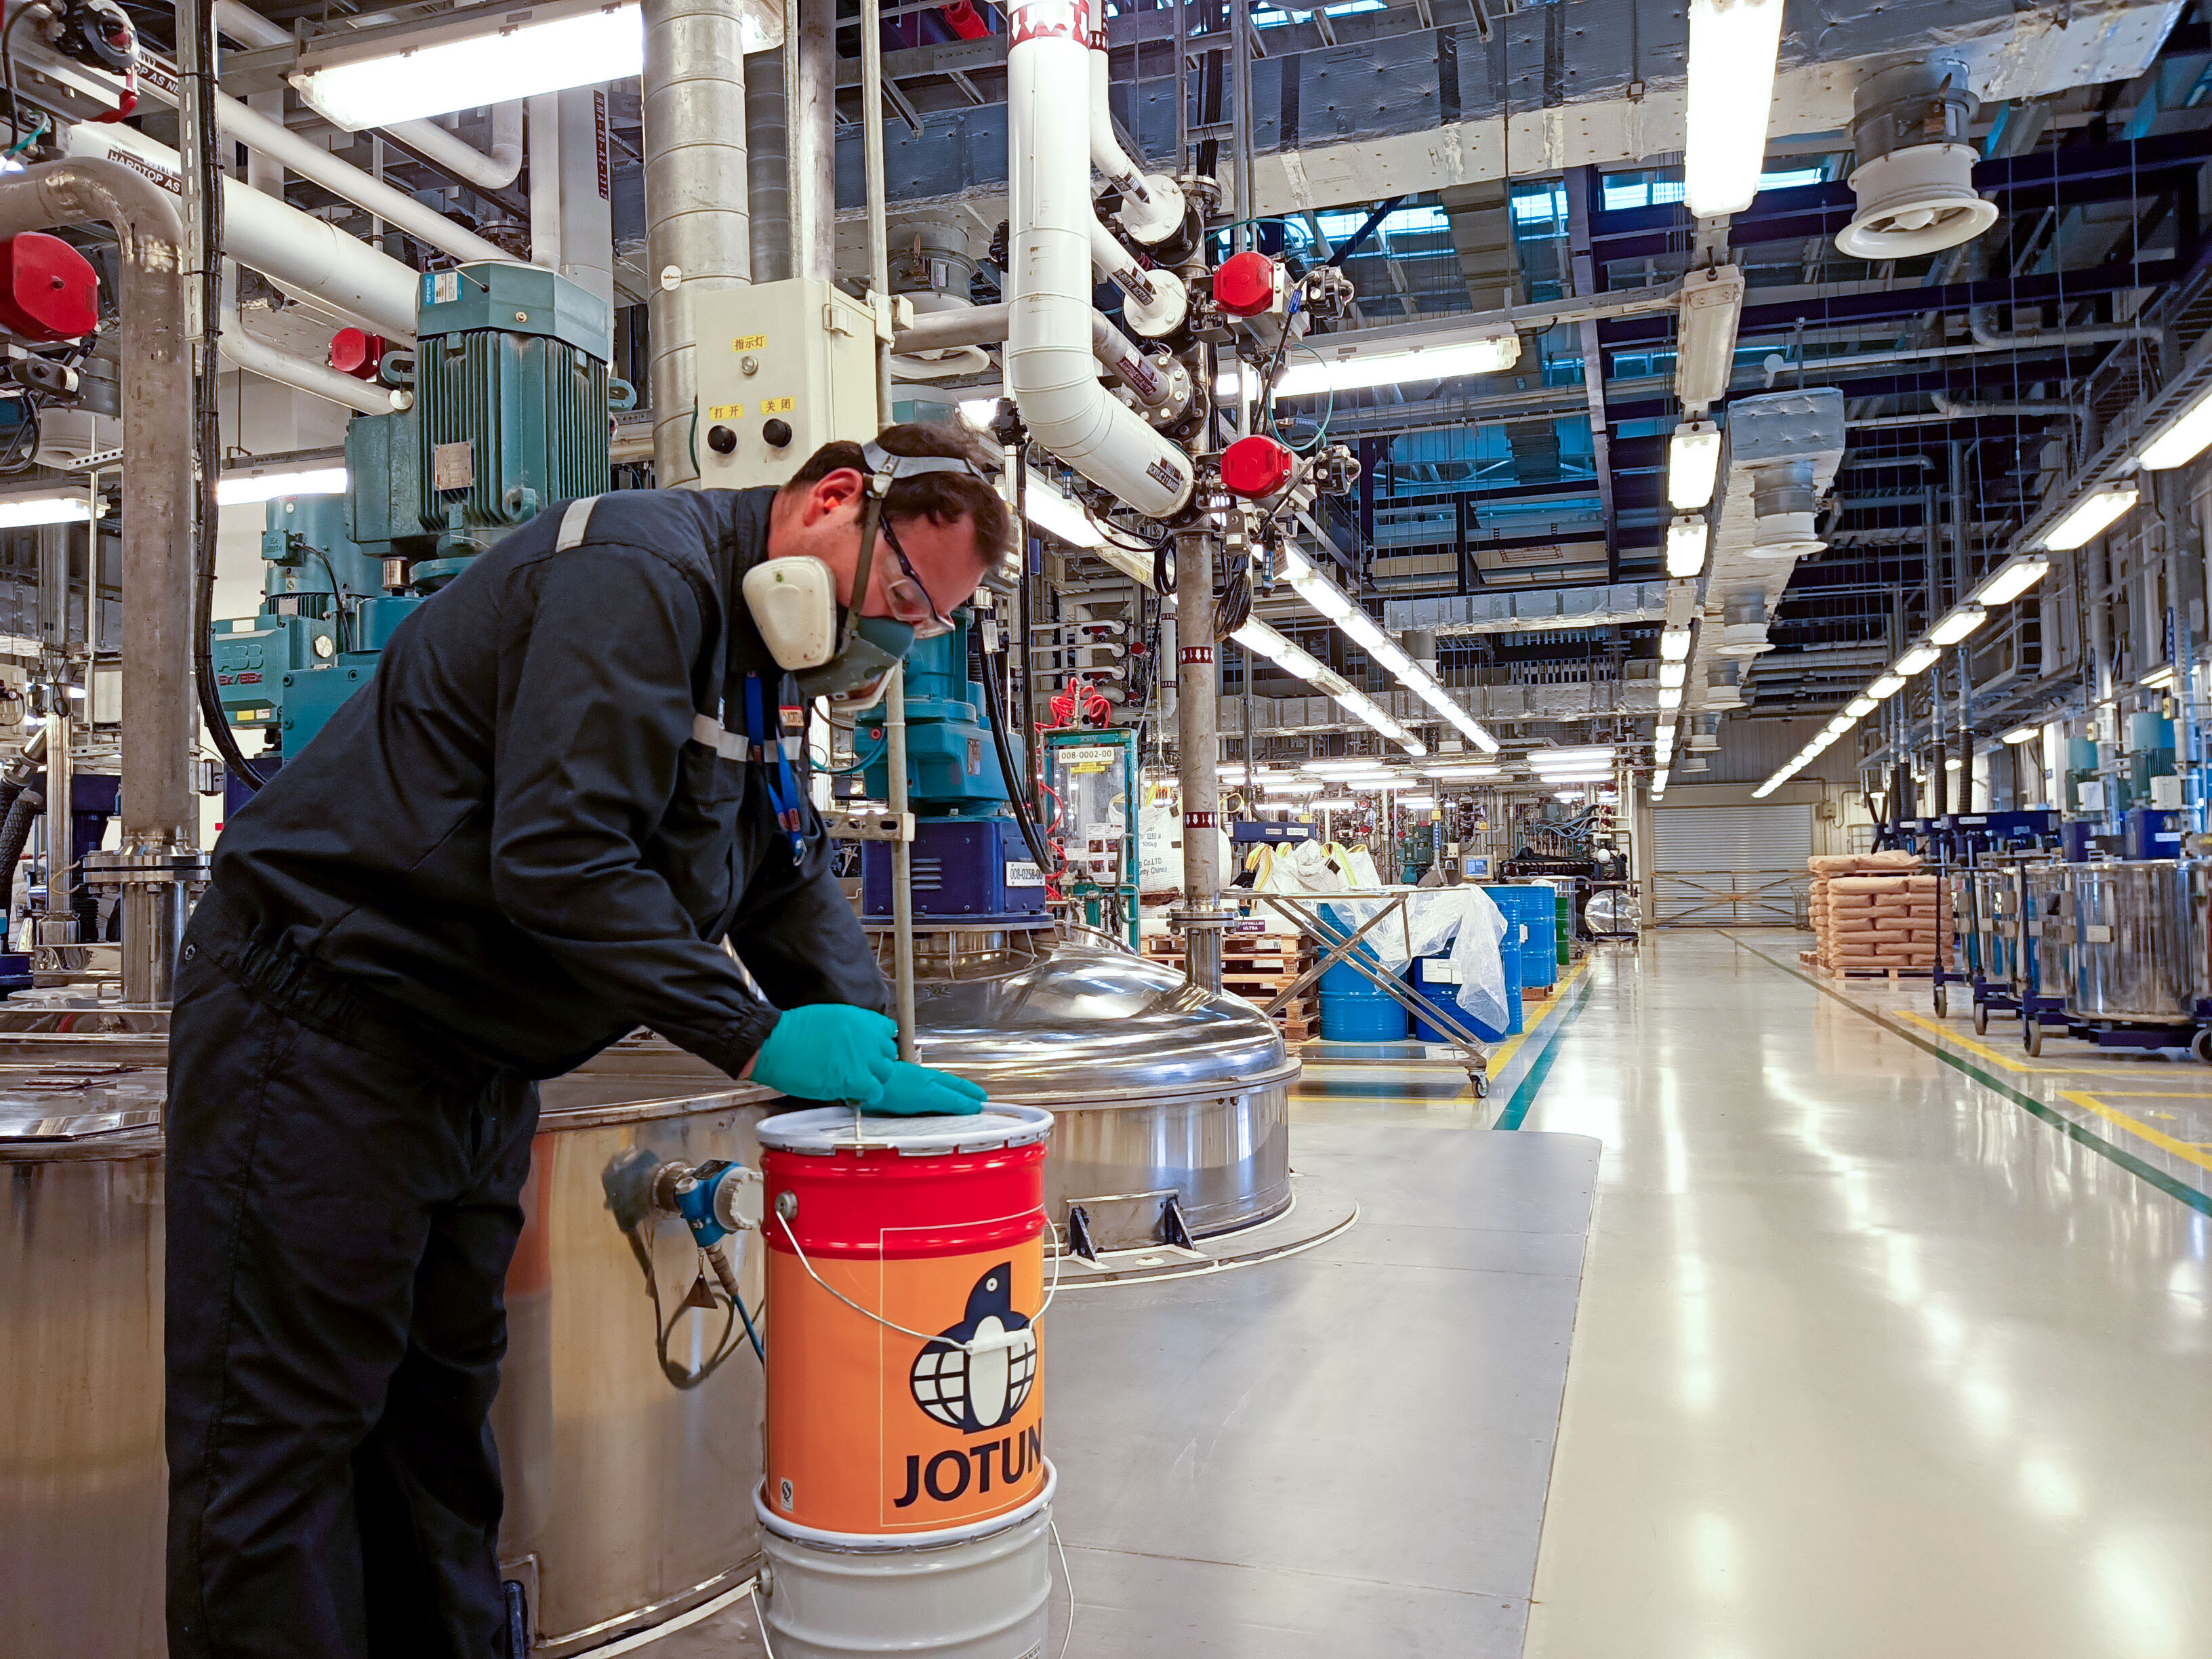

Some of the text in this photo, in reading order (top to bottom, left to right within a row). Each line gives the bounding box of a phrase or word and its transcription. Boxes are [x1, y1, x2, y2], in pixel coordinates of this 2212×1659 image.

[148, 73, 165, 85] AS
[596, 96, 608, 199] RMA-80-A2-1312
[109, 151, 163, 183] HARDTOP
[164, 178, 180, 192] AS
[1131, 285, 1152, 304] ACETATE
[735, 335, 764, 350] 指示灯
[218, 644, 264, 672] ABB
[1061, 750, 1112, 759] 008-0002-00
[1010, 868, 1043, 880] 008-0258-00
[893, 1416, 1042, 1509] JOTUN
